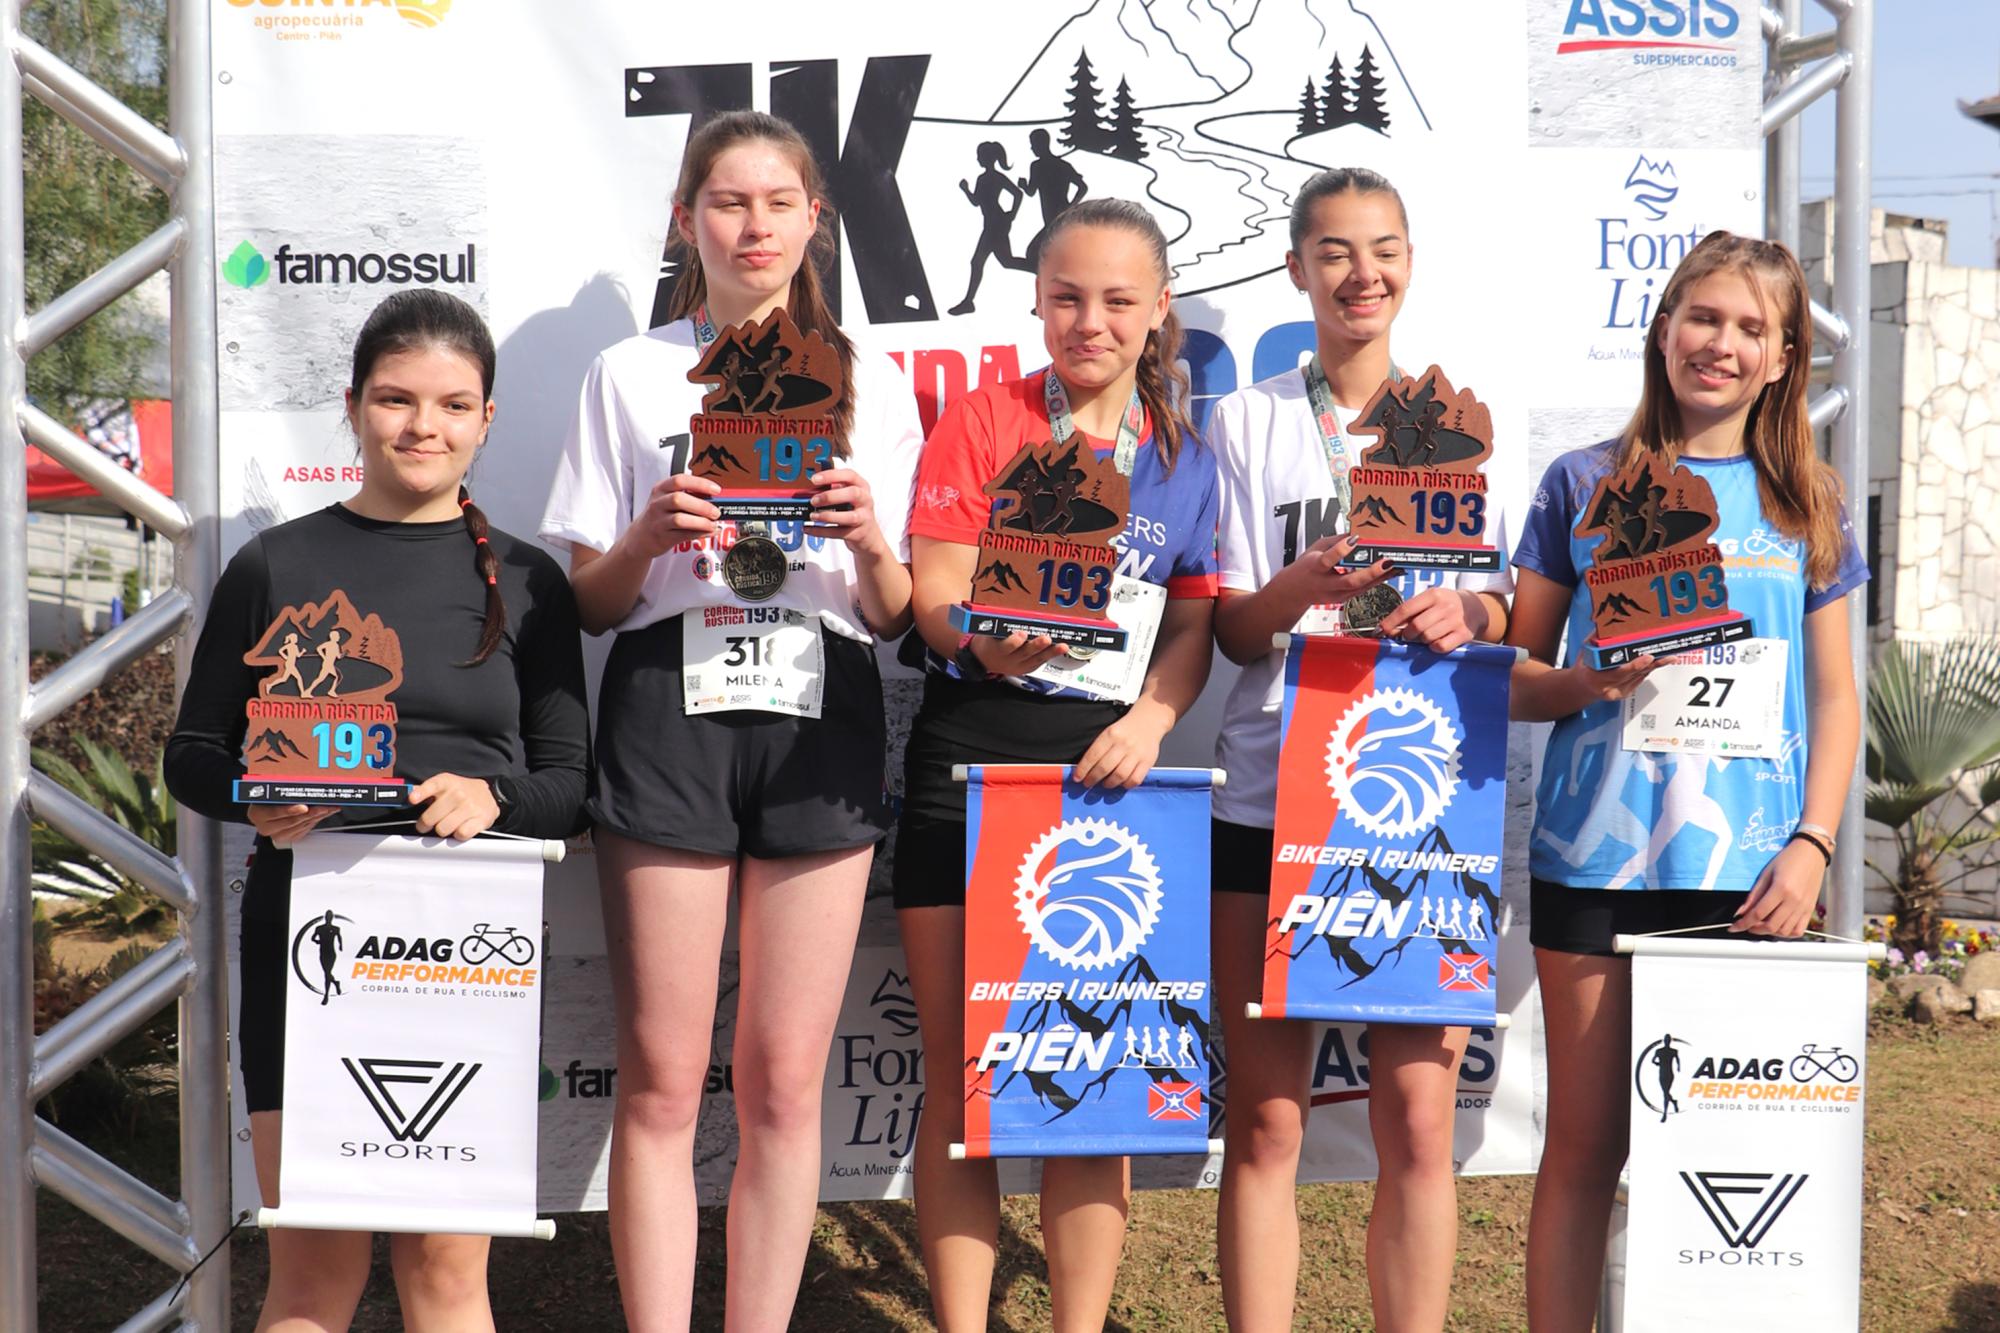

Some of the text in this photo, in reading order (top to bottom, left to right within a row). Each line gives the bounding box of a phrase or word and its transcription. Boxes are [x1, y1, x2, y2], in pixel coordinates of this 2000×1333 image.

[254, 14, 364, 29] agropecuária
[276, 32, 310, 41] Centro
[1633, 55, 1737, 67] SUPERMERCADOS
[275, 244, 475, 284] famossul
[691, 416, 835, 435] CORRIDA RÚSTICA
[1328, 435, 1345, 455] 193
[753, 437, 833, 482] 193
[284, 467, 336, 482] ASAS
[1352, 469, 1488, 491] CORRIDA RÚSTICA
[1410, 491, 1484, 537] 193
[983, 531, 1049, 556] CORRIDA
[1051, 539, 1117, 564] RÚSTICA
[1588, 561, 1655, 586] CORRIDA
[1657, 546, 1722, 571] RÚSTICA
[1037, 559, 1112, 612] 193
[1650, 565, 1726, 618] 193
[704, 606, 780, 624] CORRIDA 193
[1705, 645, 1736, 665] 193
[1687, 676, 1736, 708] 27
[249, 699, 396, 721] CORRIDA RÚSTICA
[1675, 716, 1741, 730] AMANDA
[312, 721, 393, 769] 193
[1276, 844, 1368, 868] BIKERS
[1380, 849, 1499, 874] RUNNERS
[1277, 890, 1412, 938] PIÊN
[355, 936, 454, 962] ADAG
[351, 962, 537, 987] PERFORMANCE
[361, 985, 409, 994] CORRIDA
[415, 987, 428, 995] DE
[434, 988, 455, 996] RUA
[473, 989, 526, 998] CICLISMO
[969, 982, 1065, 1001] BIKERS
[1080, 982, 1207, 1001] RUNNERS
[976, 1024, 1115, 1072] PIÊN
[1692, 1057, 1784, 1080] ADAG
[1688, 1082, 1861, 1102] PERFORMANCE
[1698, 1103, 1742, 1111] CORRIDA
[1765, 1104, 1785, 1112] RUA
[1801, 1105, 1850, 1113] CICLISMO
[844, 1092, 925, 1159] Lif
[340, 1142, 476, 1162] SPORTS
[829, 1162, 914, 1177] ÁGUA MINERAL
[1678, 1250, 1804, 1267] SPORTS
